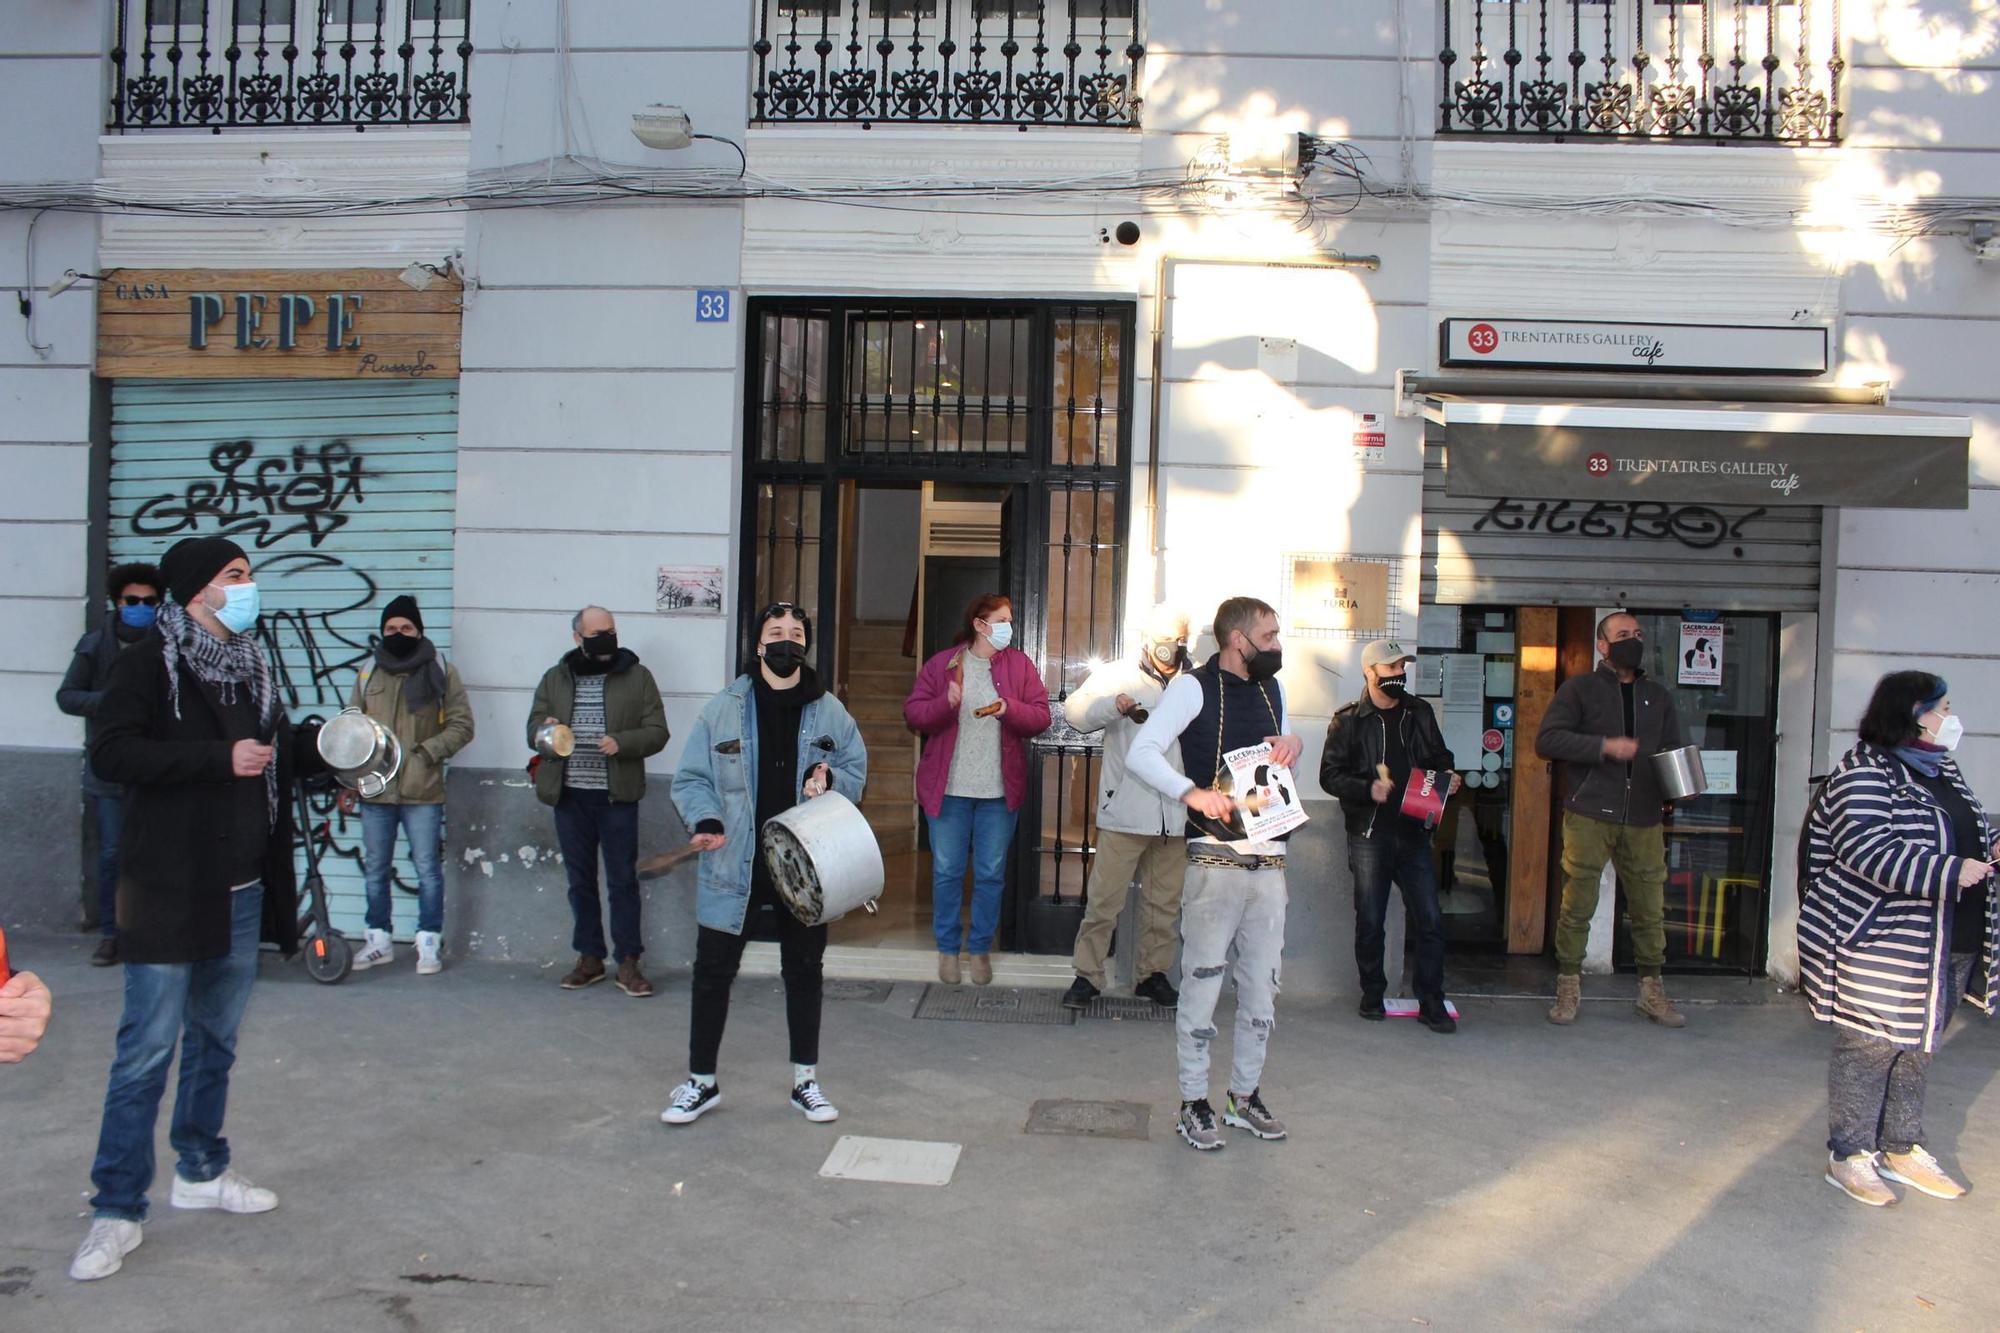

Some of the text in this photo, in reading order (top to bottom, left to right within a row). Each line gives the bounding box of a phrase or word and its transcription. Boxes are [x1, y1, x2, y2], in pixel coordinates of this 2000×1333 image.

[116, 284, 170, 300] CASA
[700, 295, 724, 318] 33
[188, 293, 363, 351] PEPE
[1473, 331, 1654, 347] 33 TRENTATRES GALLERY
[1632, 341, 1664, 365] café
[1590, 458, 1788, 476] 33 TRENTATRES GALLERY
[1770, 474, 1799, 496] café
[1322, 600, 1358, 609] TURIA
[1421, 769, 1437, 797] CINZANO
